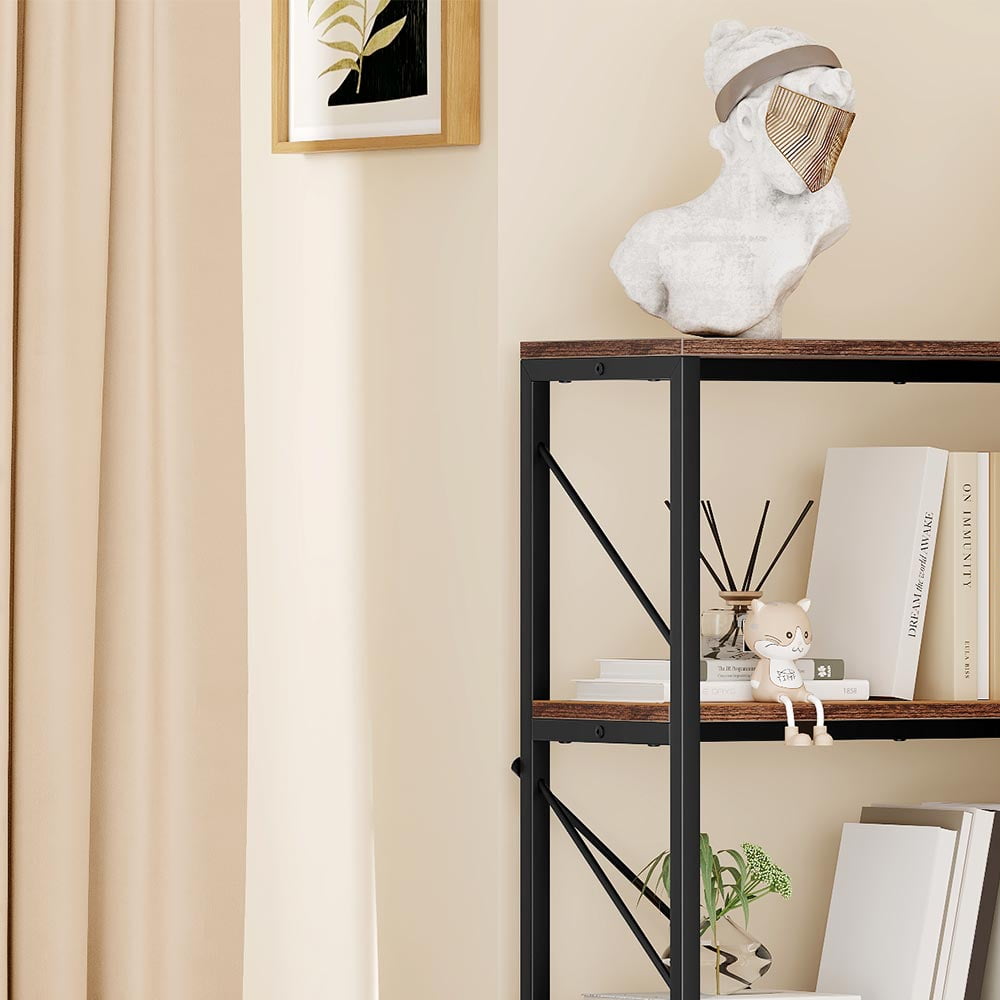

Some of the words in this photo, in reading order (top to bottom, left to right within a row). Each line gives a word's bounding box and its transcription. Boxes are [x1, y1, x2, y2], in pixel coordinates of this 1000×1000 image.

[963, 483, 972, 503] ON
[907, 594, 922, 638] DREAM
[919, 511, 935, 554] AWAKE
[963, 511, 972, 589] IMMUNITY
